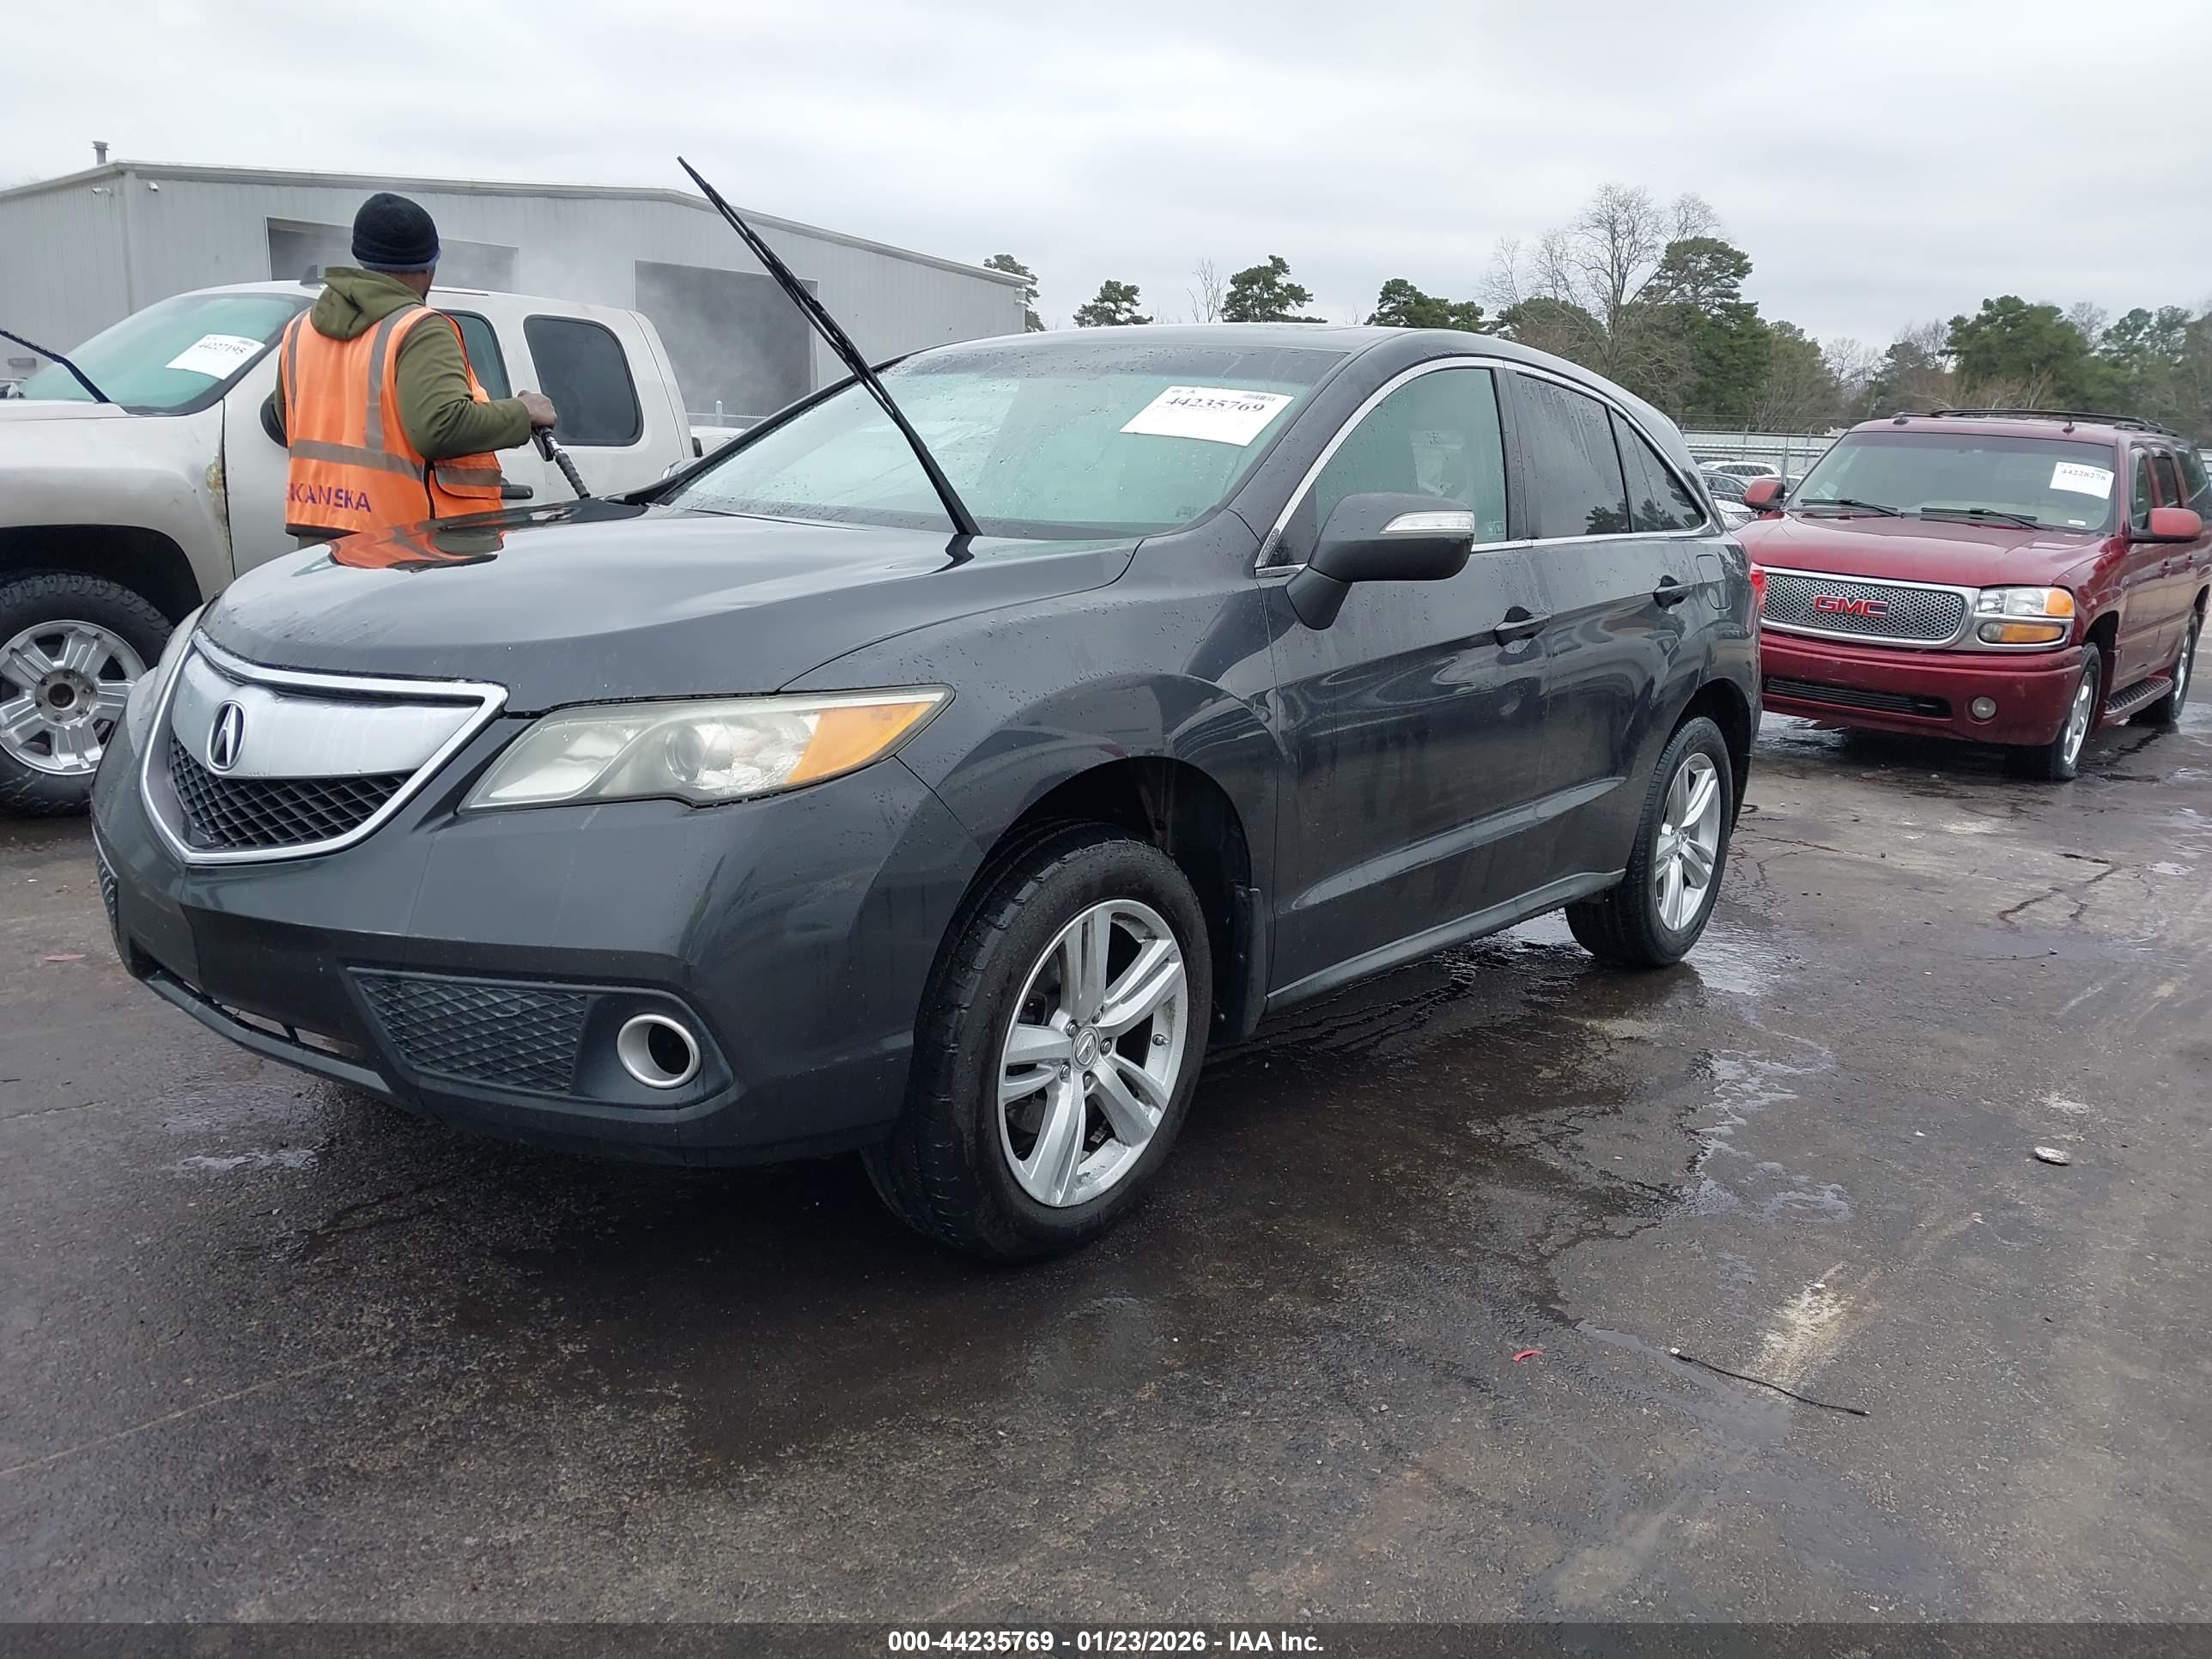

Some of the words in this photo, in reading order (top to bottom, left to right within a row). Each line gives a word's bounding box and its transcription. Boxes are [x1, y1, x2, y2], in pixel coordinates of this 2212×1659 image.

[1165, 397, 1265, 412] 44235769
[286, 482, 371, 513] KANSKA
[1814, 595, 1888, 618] GMC
